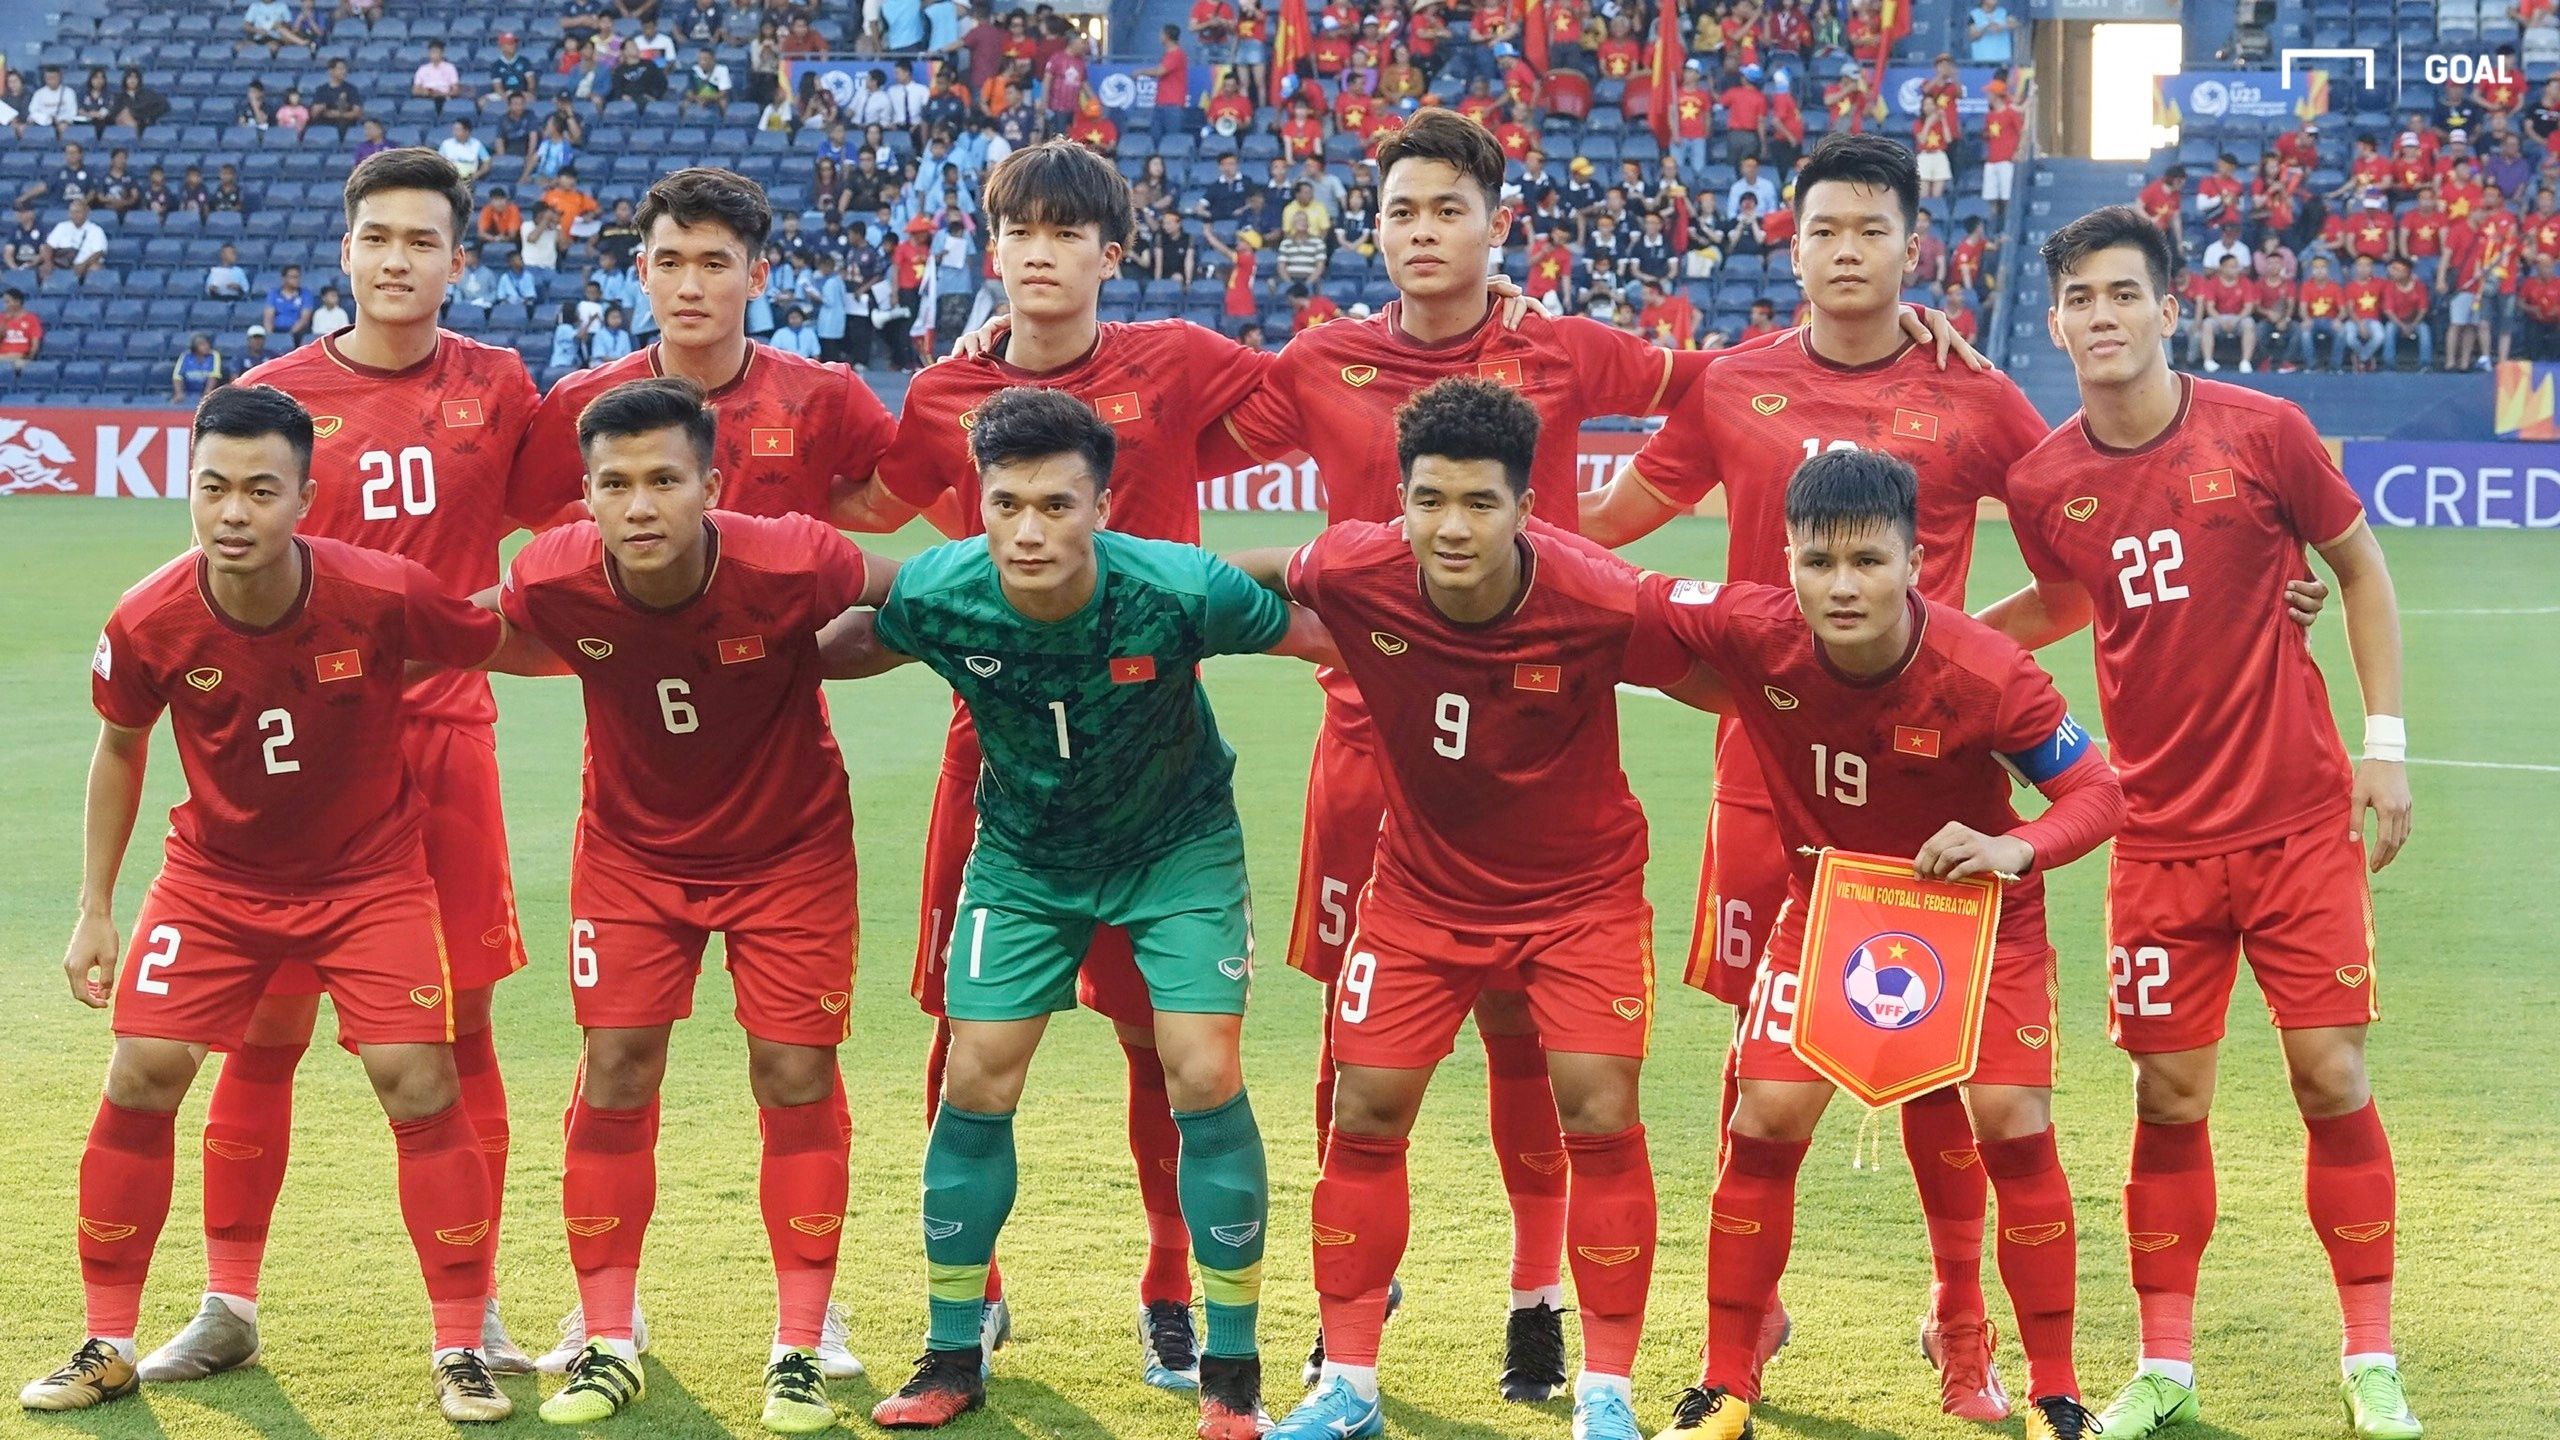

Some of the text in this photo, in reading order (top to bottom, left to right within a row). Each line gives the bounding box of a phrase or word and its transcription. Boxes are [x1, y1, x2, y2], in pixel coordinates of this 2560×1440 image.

[359, 445, 436, 521] 20
[2374, 464, 2560, 528] CRED
[2111, 528, 2190, 609] 22
[657, 678, 700, 734] 6
[1048, 701, 1071, 759] 1
[1433, 692, 1470, 760] 9
[257, 708, 300, 775] 2
[1810, 743, 1868, 808] 19
[1318, 876, 1348, 946] 5
[1715, 894, 1752, 969] 16
[1836, 881, 1979, 917] VIETNAM FOOTBALL FEDERATION
[137, 925, 182, 996] 2
[572, 918, 599, 988] 6
[969, 907, 989, 978] 1
[1340, 951, 1377, 1024] 9
[1751, 970, 1799, 1044] 19
[1875, 1003, 1905, 1018] VFF
[2111, 945, 2172, 1016] 22
